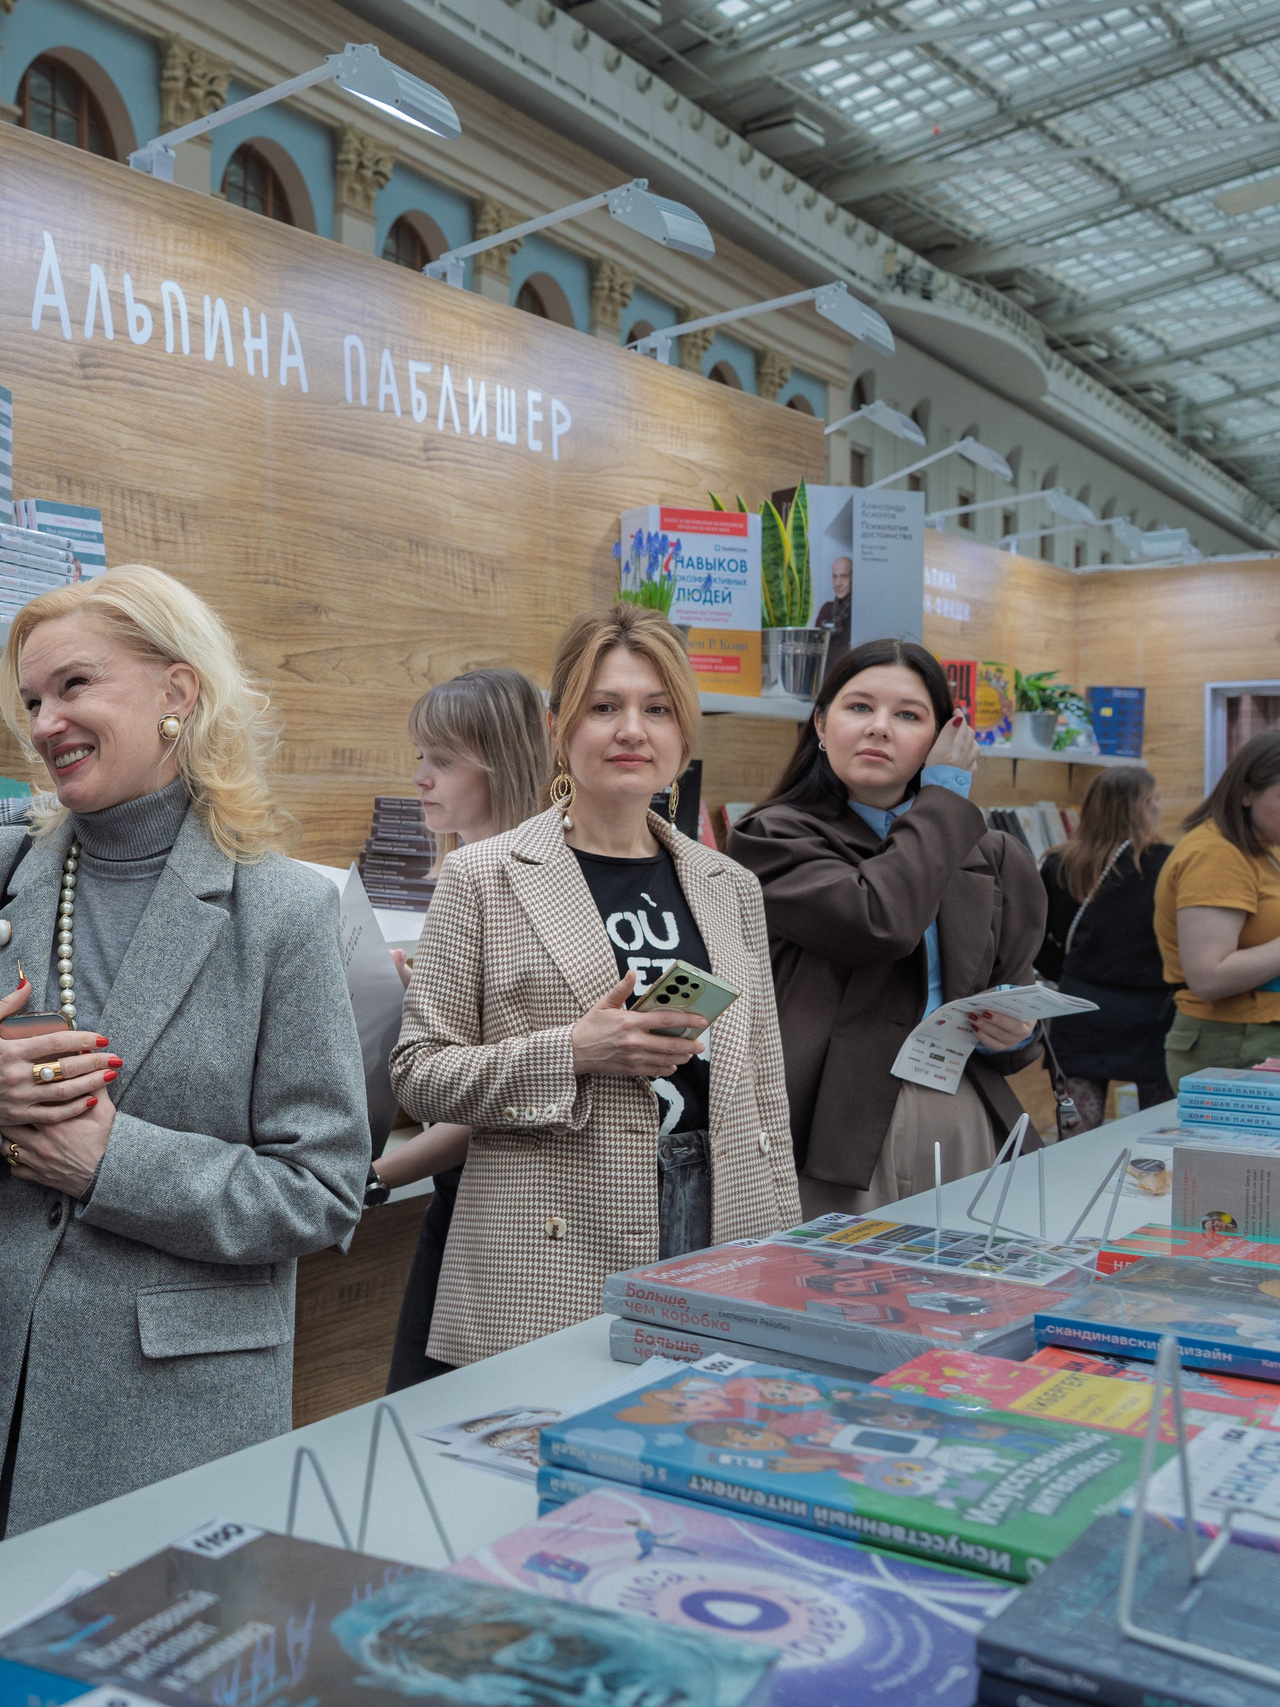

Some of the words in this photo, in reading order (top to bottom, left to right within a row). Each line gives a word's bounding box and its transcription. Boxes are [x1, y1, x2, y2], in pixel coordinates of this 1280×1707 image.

[343, 334, 572, 461] ПАБЛИШЕР
[675, 556, 748, 574] НАВЫКОВ
[675, 575, 747, 586] ОКОЭФКТИВНЫХ
[675, 586, 732, 605] ЛЮДЕЙ
[606, 892, 680, 950] OÙ
[1235, 1087, 1274, 1097] ПАМЯТЬ
[1233, 1102, 1272, 1112] ПАМЯТЬ
[1233, 1117, 1272, 1126] ПАМЯТЬ
[625, 1282, 691, 1312] Больше,
[624, 1297, 656, 1318] чем
[661, 1305, 731, 1333] коробка
[718, 1309, 758, 1326] Екатерина
[633, 1328, 704, 1355] Больше,
[1046, 1323, 1170, 1353] скандинавски
[1176, 1340, 1233, 1363] дизайн
[964, 1429, 1112, 1526] Искусственный
[688, 1473, 808, 1519] интеллект
[813, 1502, 1012, 1574] Искусственный
